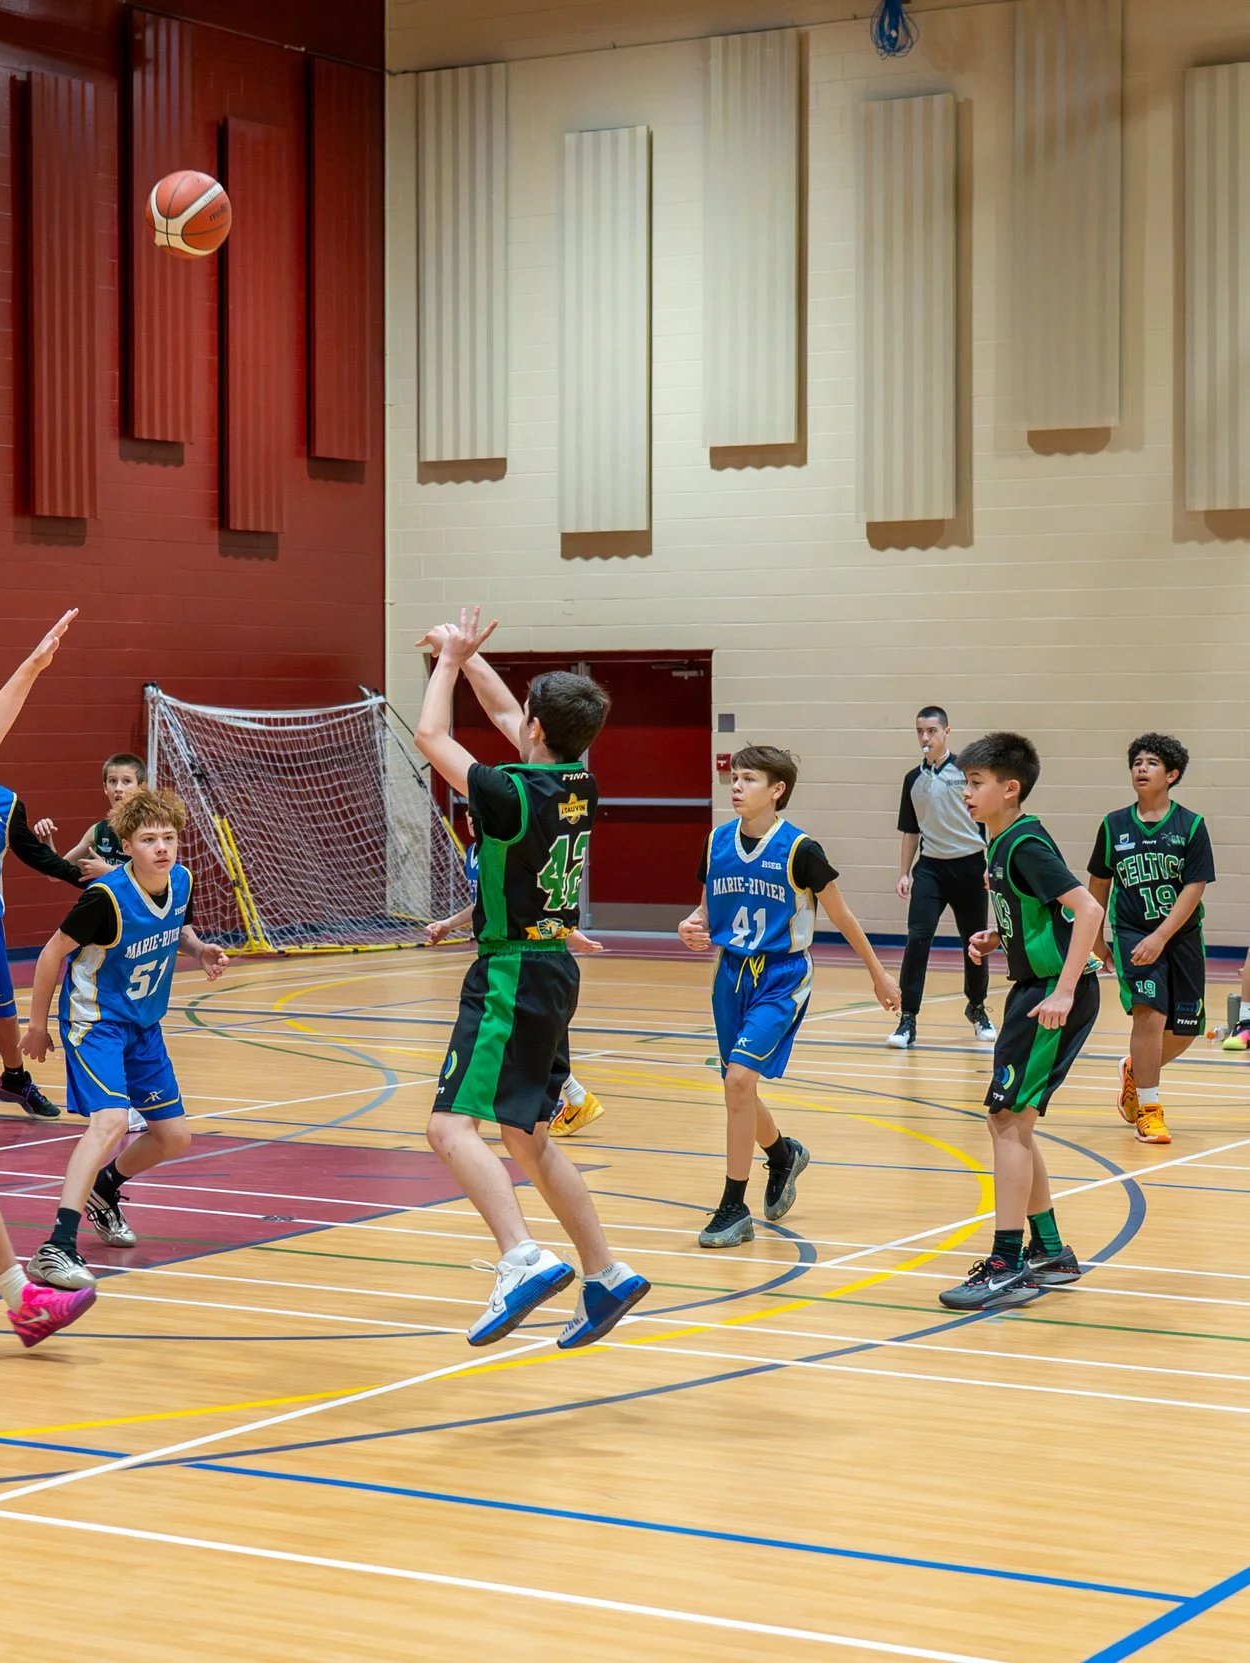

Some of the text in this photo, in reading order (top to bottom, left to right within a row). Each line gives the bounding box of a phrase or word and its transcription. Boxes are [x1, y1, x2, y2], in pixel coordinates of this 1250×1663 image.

[536, 830, 592, 912] 42
[712, 876, 786, 903] MARIE-RIVIER
[1139, 884, 1178, 921] 19
[729, 905, 767, 951] 41
[125, 955, 170, 1001] 51
[1135, 979, 1156, 998] 19
